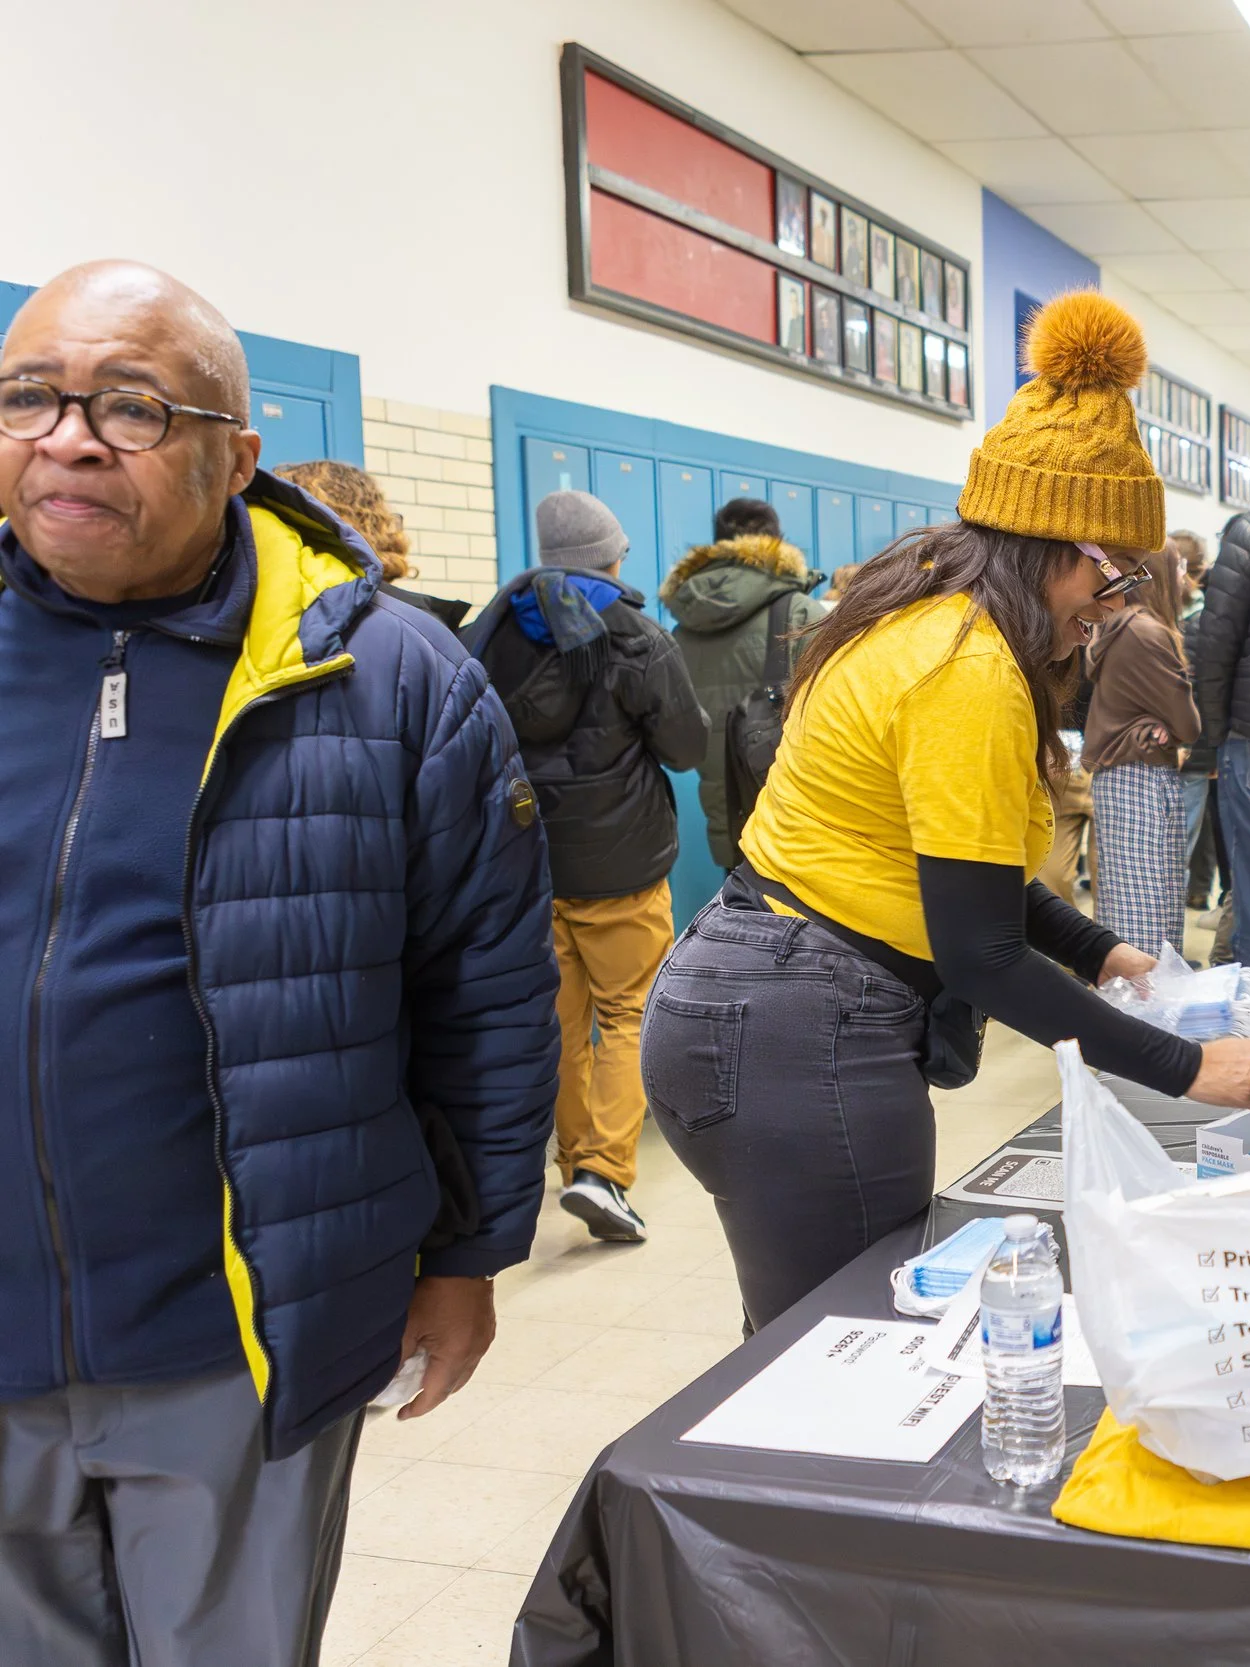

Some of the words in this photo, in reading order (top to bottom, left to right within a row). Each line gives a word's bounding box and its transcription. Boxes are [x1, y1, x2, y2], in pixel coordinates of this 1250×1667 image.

[1201, 1149, 1230, 1161] DISPOSABLE
[1201, 1156, 1216, 1165] FACE
[1216, 1159, 1235, 1170] MASK
[991, 1160, 1019, 1178] SCAN
[979, 1176, 999, 1187] ME
[925, 1374, 961, 1405] GUEST
[903, 1407, 933, 1428] WIFI
